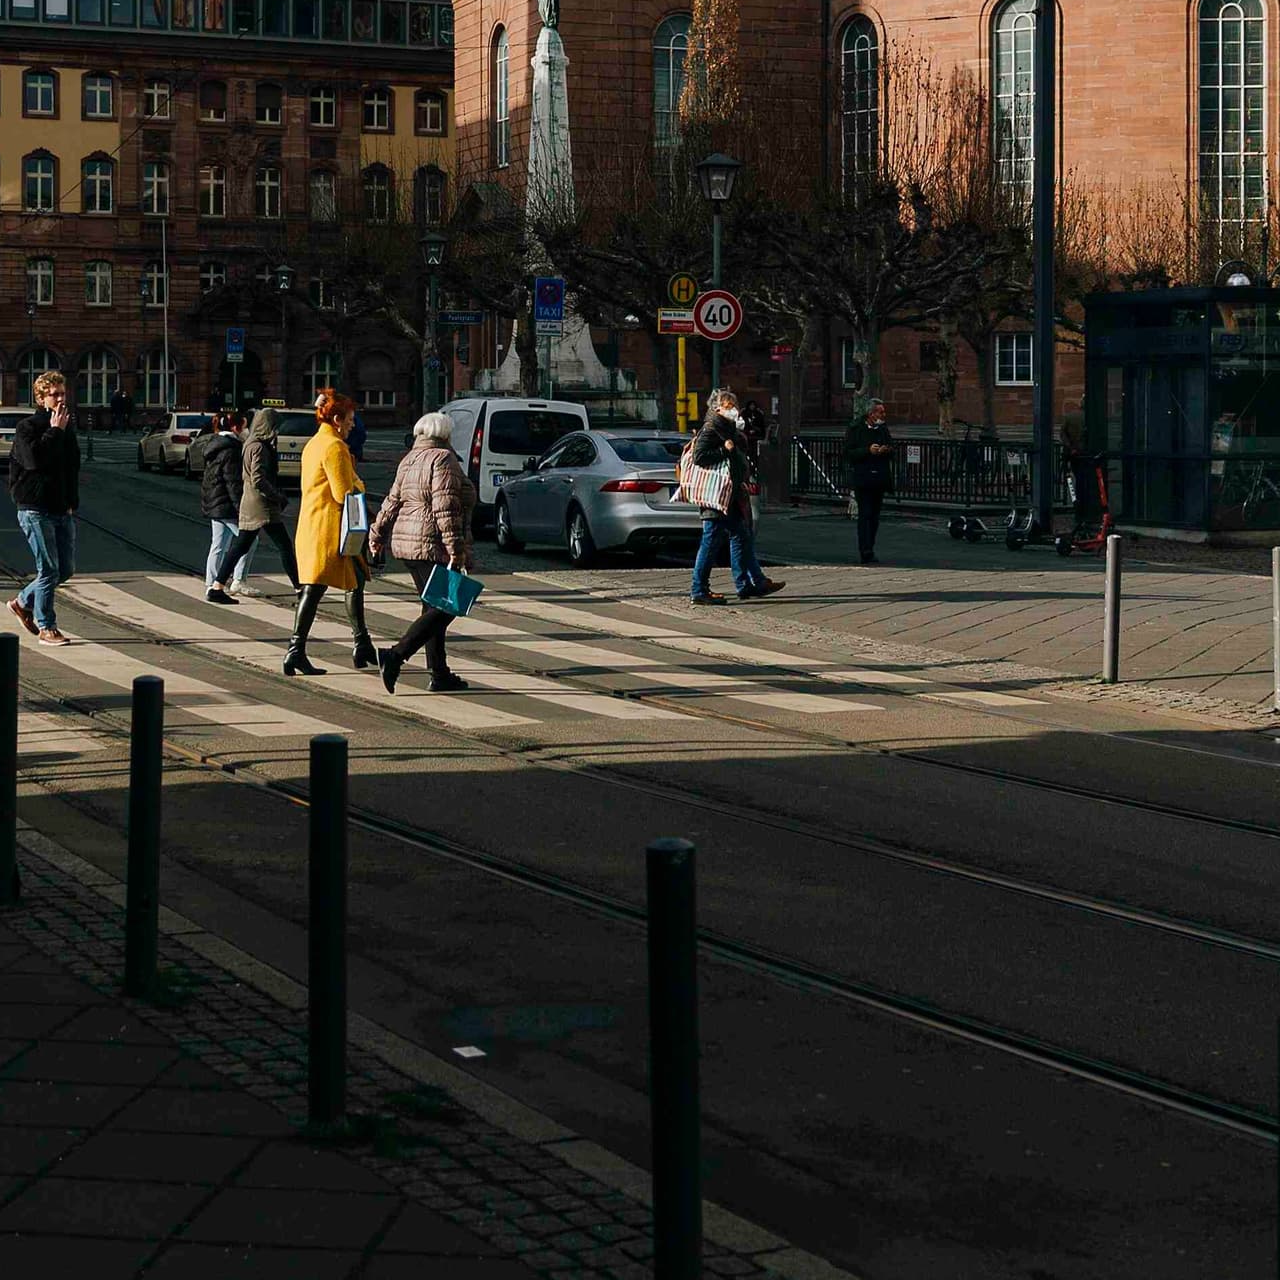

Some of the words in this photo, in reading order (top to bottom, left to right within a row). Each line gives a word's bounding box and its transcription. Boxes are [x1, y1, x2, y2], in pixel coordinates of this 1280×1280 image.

[677, 281, 690, 300] H
[539, 307, 561, 318] TAXI
[704, 304, 732, 326] 40
